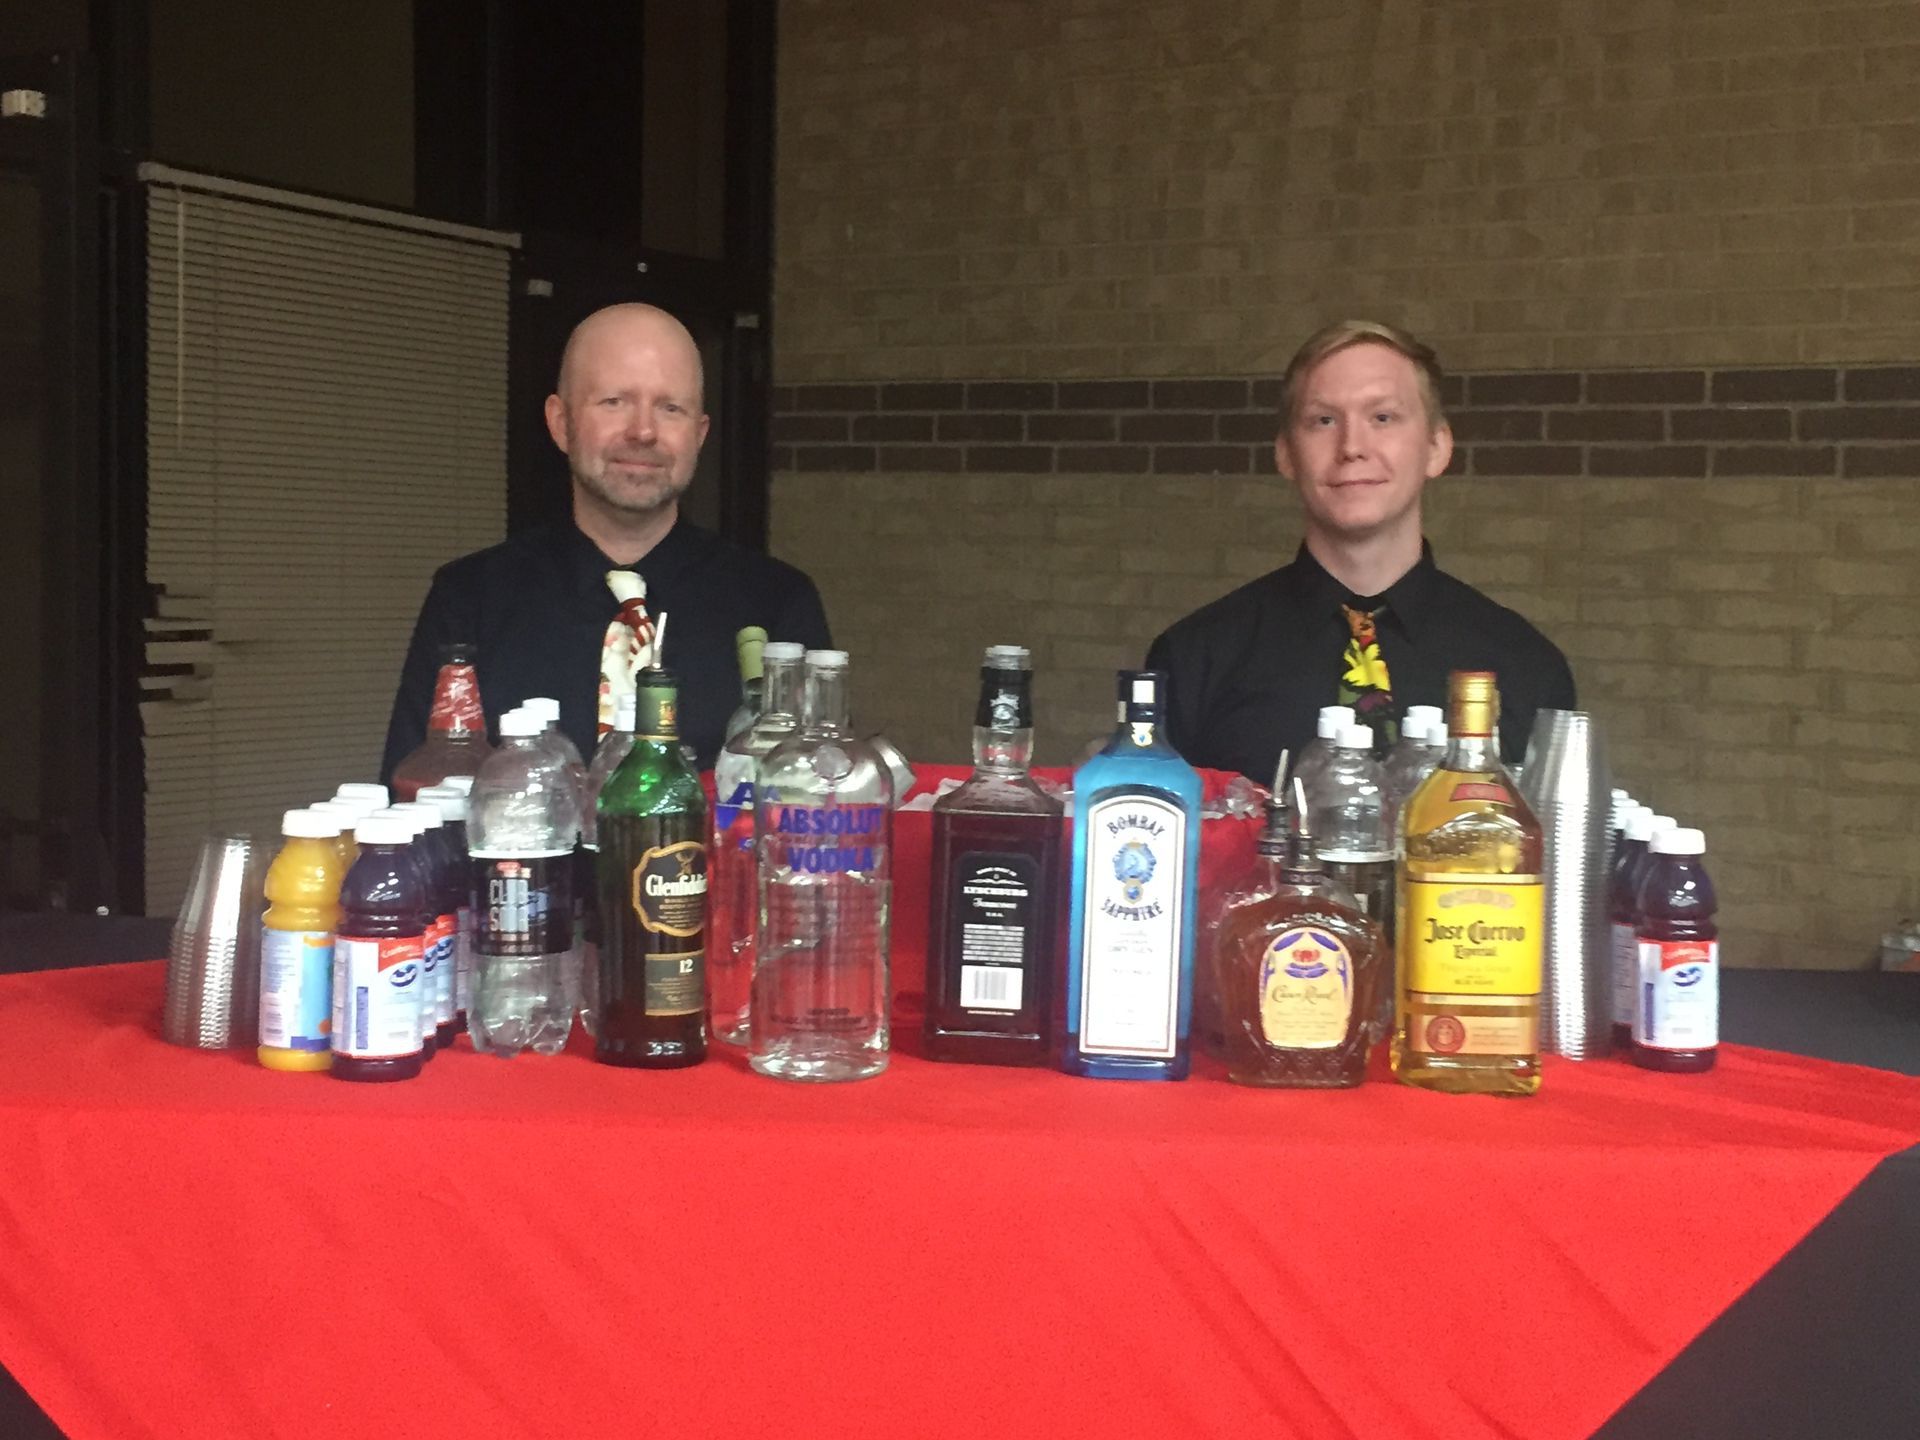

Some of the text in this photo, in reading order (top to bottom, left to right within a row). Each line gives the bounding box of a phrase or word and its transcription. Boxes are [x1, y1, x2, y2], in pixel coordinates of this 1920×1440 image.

[778, 808, 882, 834] ABSOLUT
[1106, 814, 1166, 837] BOMBAY
[787, 847, 875, 873] VODKA
[1100, 898, 1163, 921] SAPPHIRE
[1424, 918, 1526, 944] Jose Cuervo
[679, 958, 694, 974] 12
